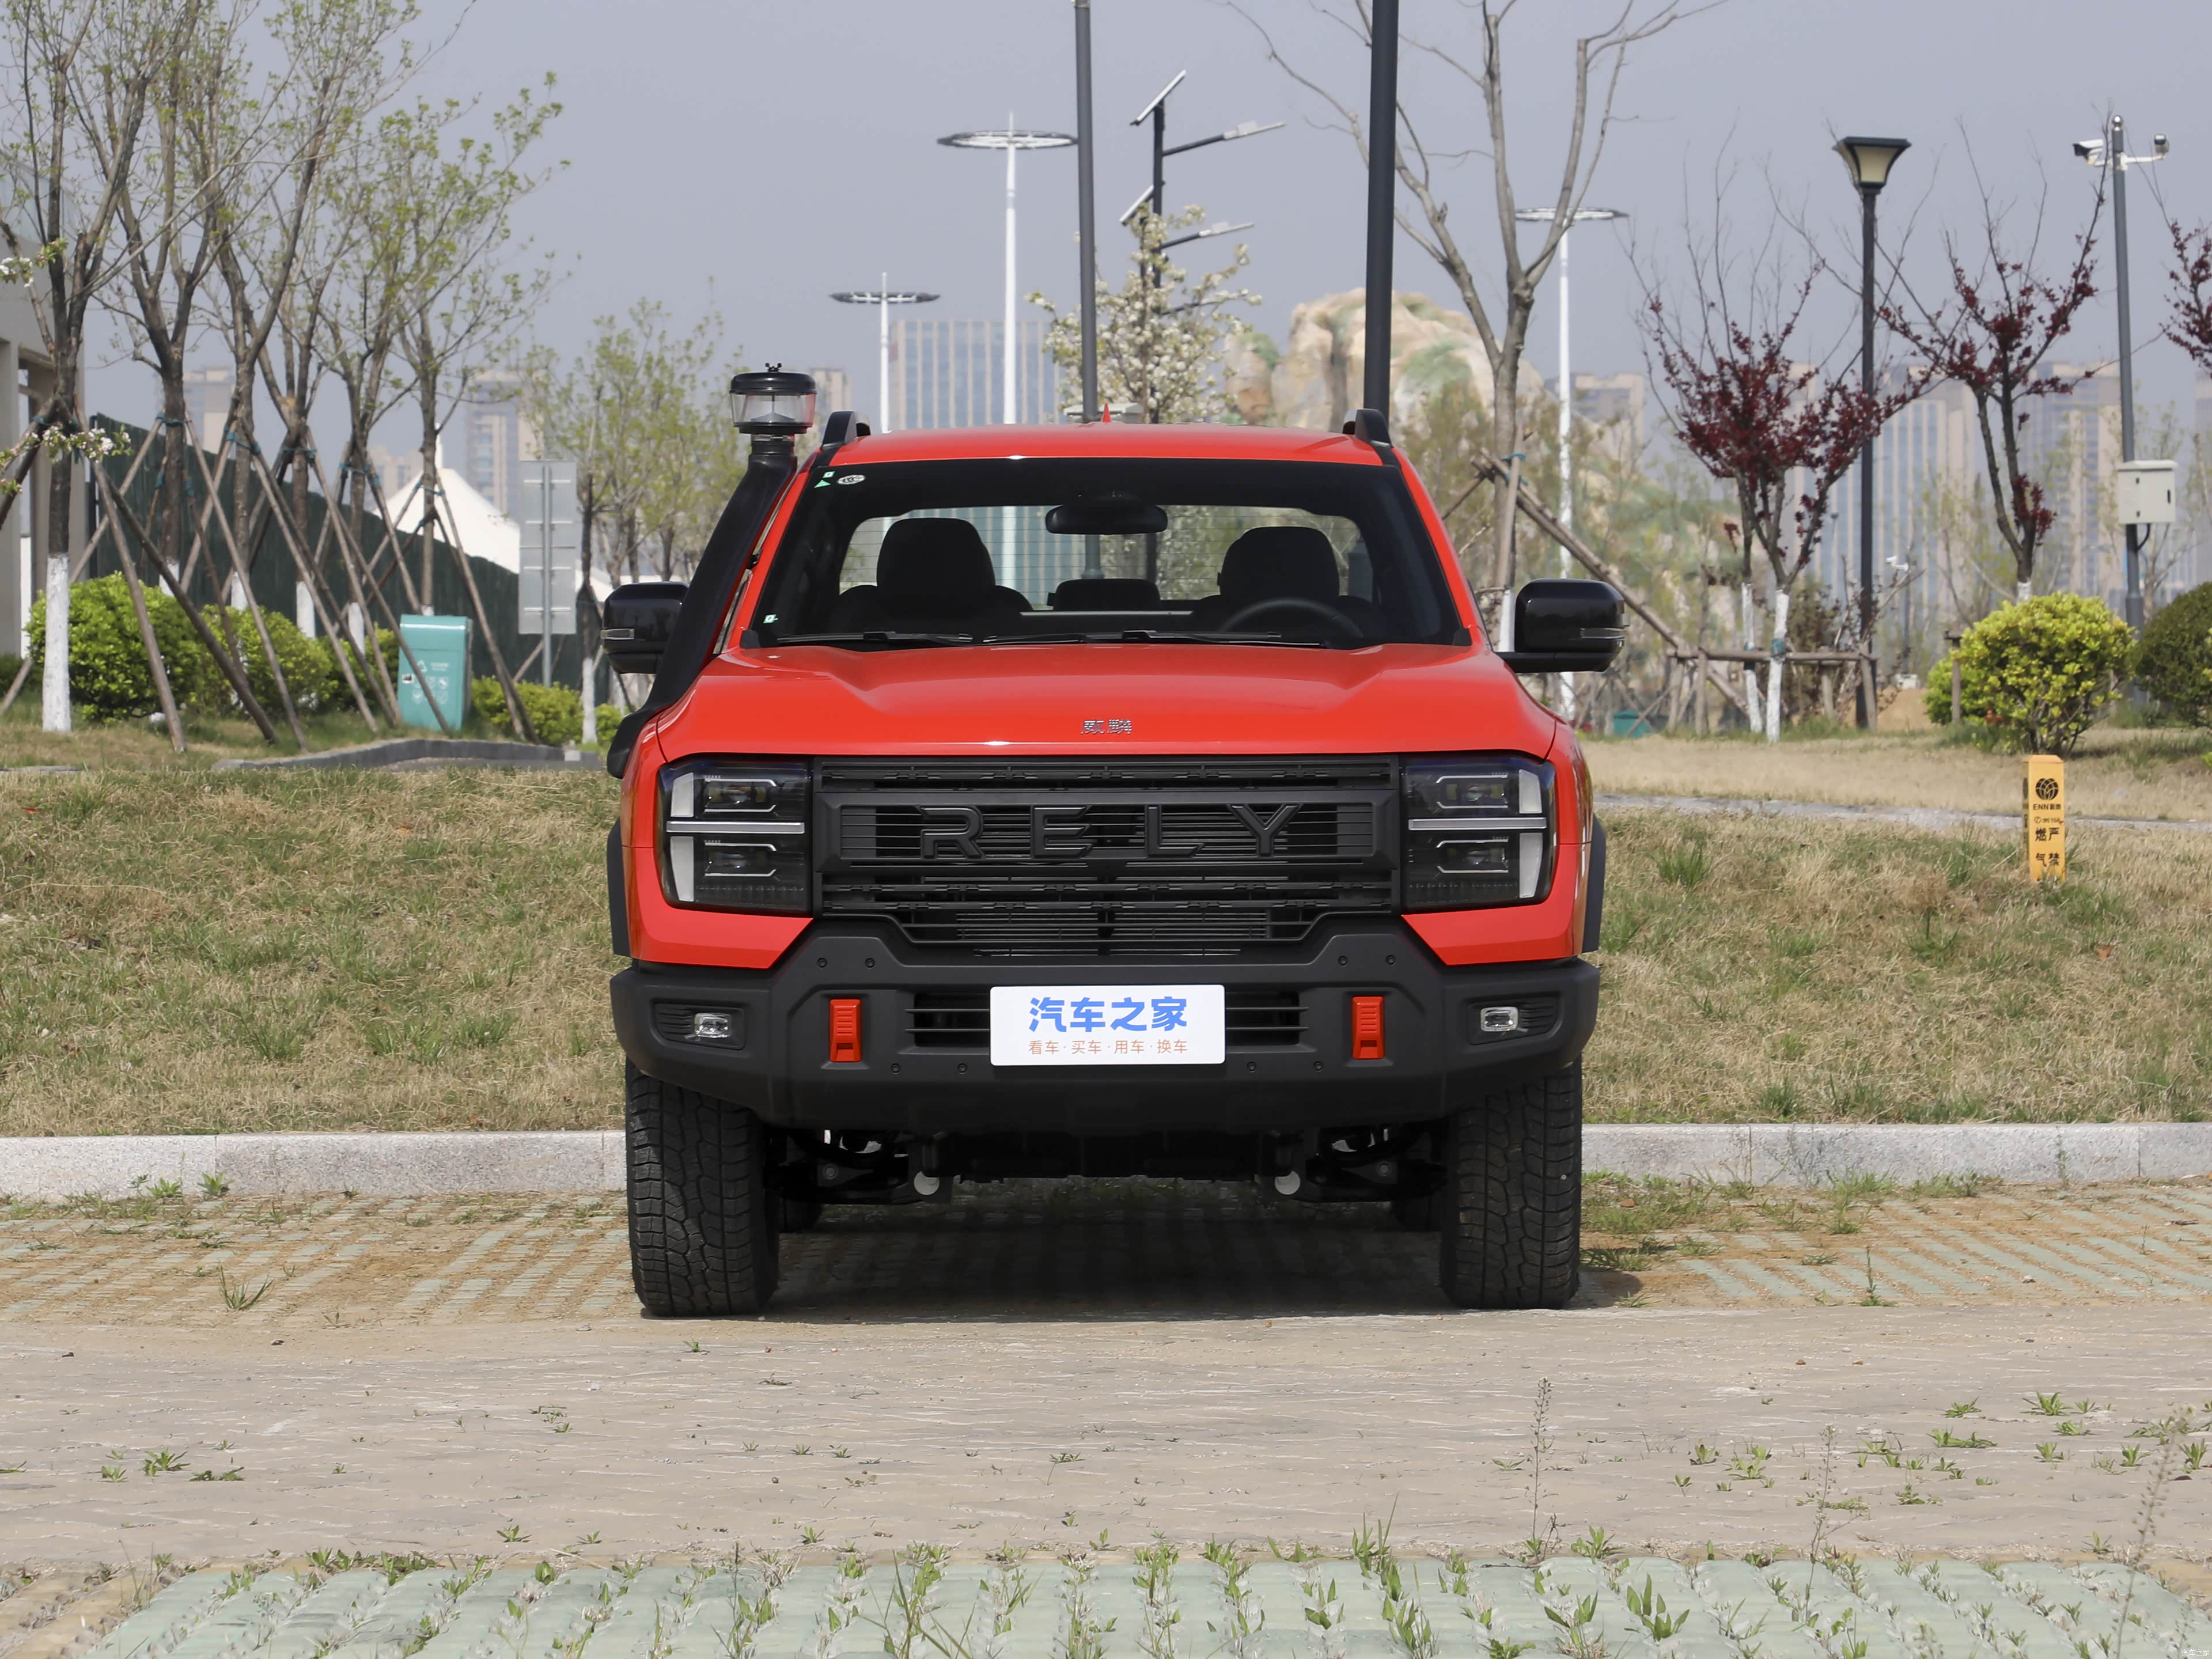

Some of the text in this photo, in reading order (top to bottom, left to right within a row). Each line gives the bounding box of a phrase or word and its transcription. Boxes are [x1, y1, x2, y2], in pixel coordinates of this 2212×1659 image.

[916, 804, 1303, 860] RELY
[1028, 996, 1188, 1033] 汽车之家
